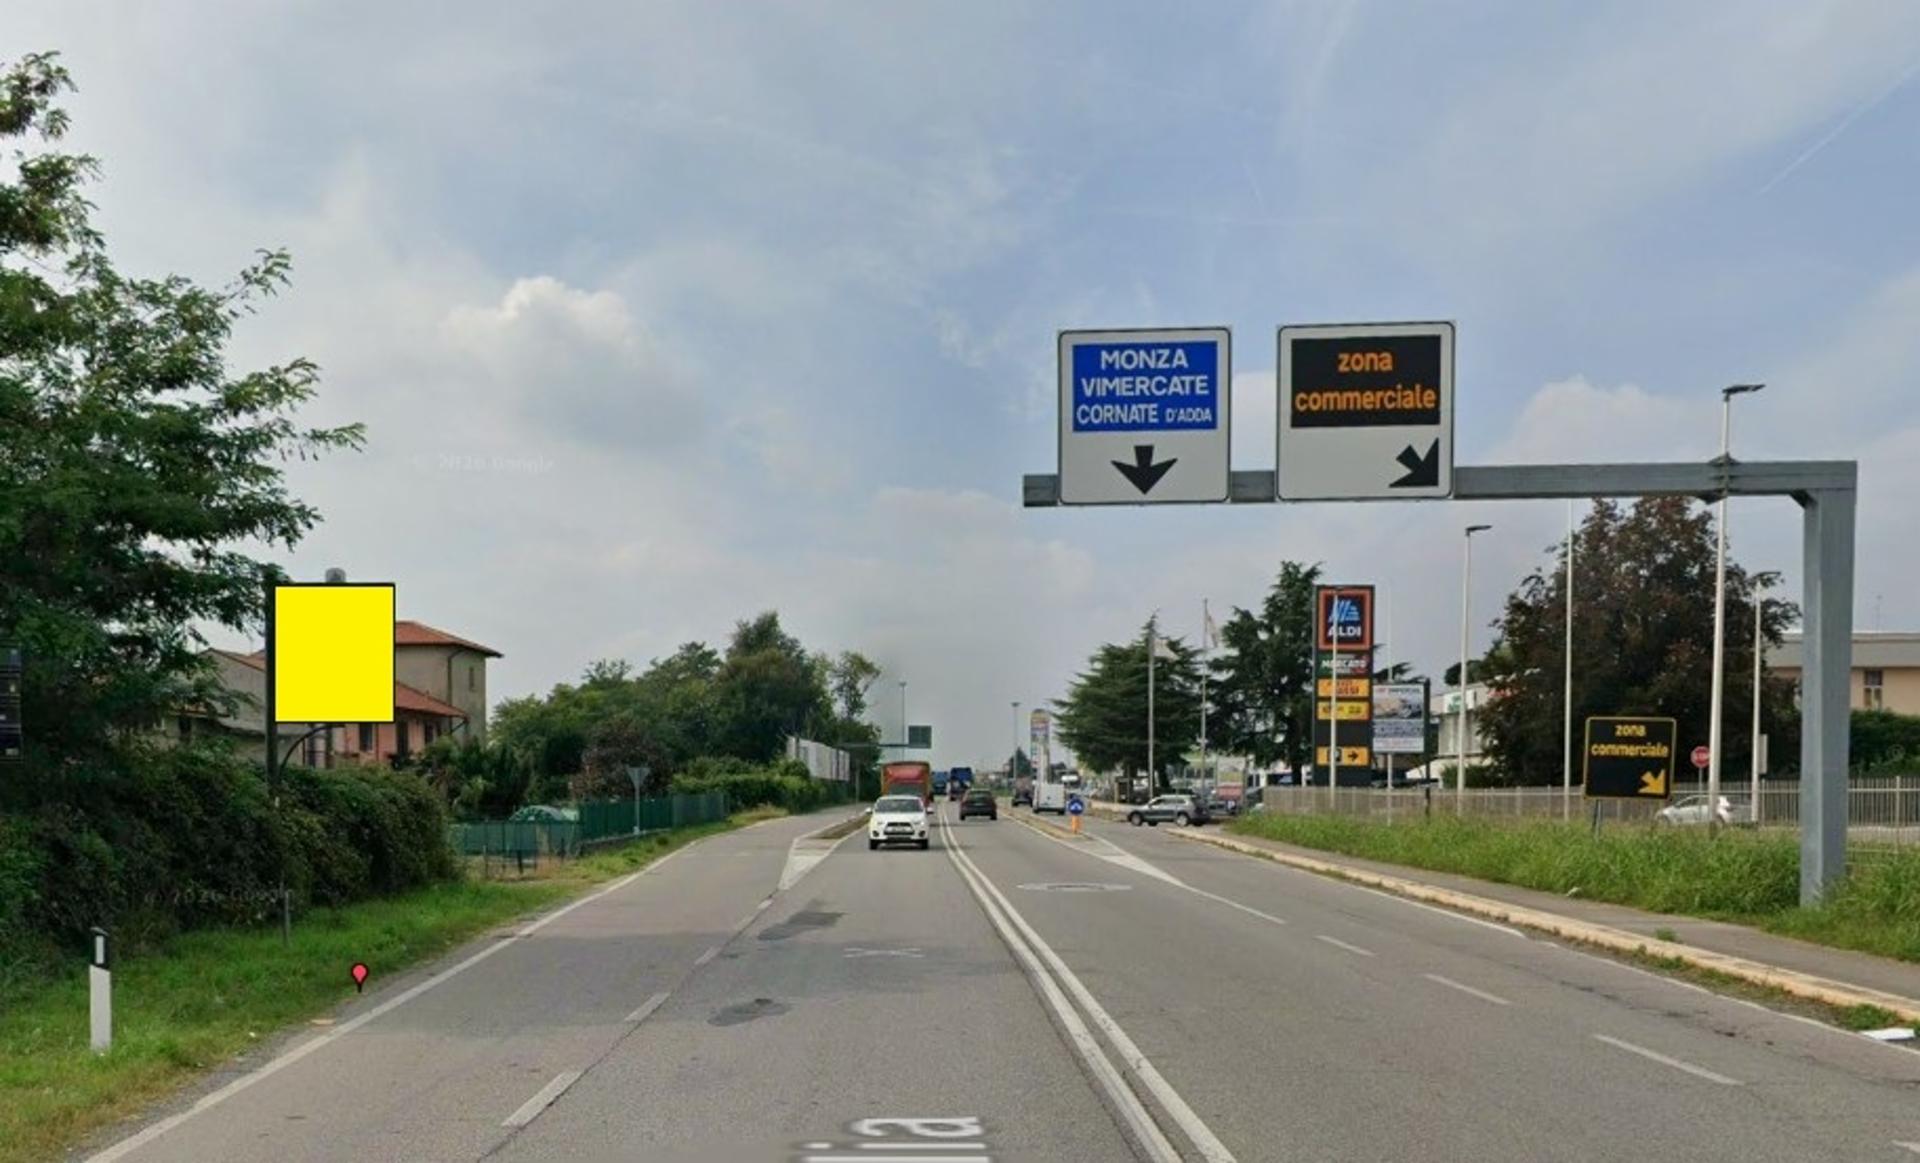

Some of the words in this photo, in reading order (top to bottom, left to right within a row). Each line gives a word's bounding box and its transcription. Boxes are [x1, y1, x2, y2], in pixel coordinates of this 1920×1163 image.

[1100, 348, 1189, 371] MONZA
[1337, 350, 1393, 373] zona
[1080, 374, 1209, 397] VIMERCATE
[1295, 384, 1436, 412] commerciale
[1076, 403, 1159, 425] CORNATE
[1165, 406, 1213, 423] D'ADDA
[1327, 625, 1362, 637] ALDI
[1615, 724, 1646, 737] zona
[1591, 742, 1669, 758] commerciale
